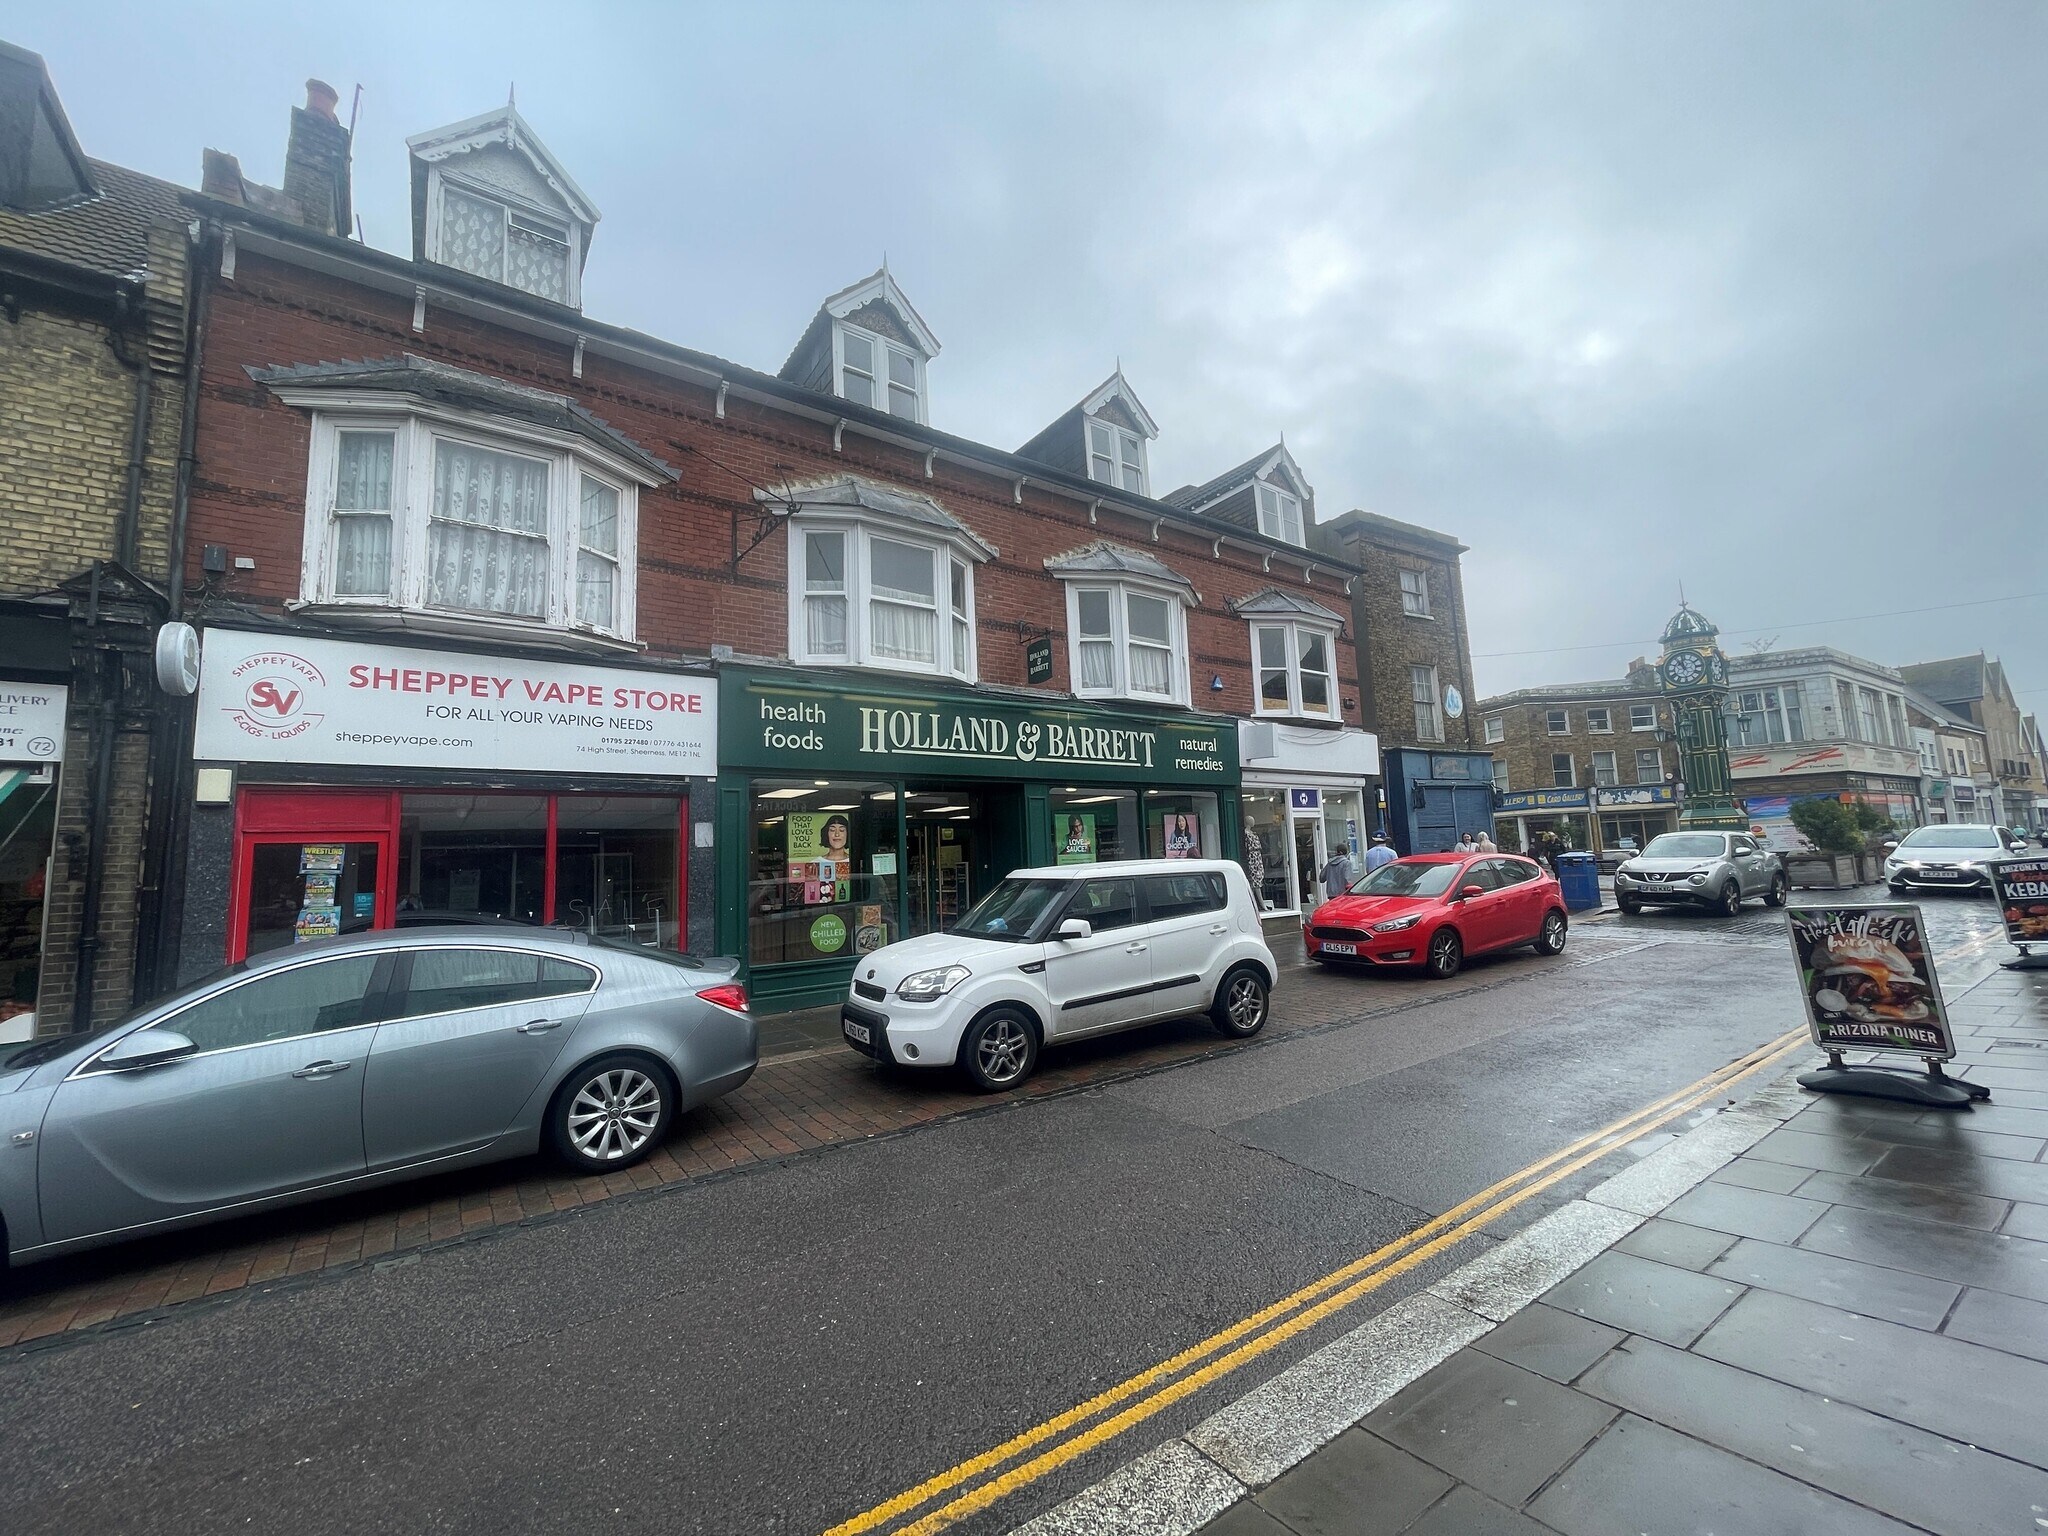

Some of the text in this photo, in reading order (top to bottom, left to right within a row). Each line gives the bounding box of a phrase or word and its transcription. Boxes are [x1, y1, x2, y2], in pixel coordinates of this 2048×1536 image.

[232, 657, 318, 682] SHEPPEY VAPE
[349, 665, 702, 714] SHEPPEY VAPE STORE
[251, 681, 300, 716] SV
[426, 705, 653, 731] FOR ALL YOUR VAPING NEEDS
[760, 698, 826, 724] health
[272, 720, 311, 739] LIQUIDS
[859, 707, 1156, 768] HOLLAND & BARRETT
[33, 741, 51, 752] 72
[335, 731, 473, 748] sheppeyvape.com
[601, 737, 623, 745] 01795
[763, 726, 824, 751] foods
[1179, 737, 1217, 753] natural
[587, 746, 604, 755] High
[1175, 756, 1224, 772] remedies
[304, 847, 343, 855] WRESTLING
[1066, 845, 1087, 853] SAUCE?
[1999, 863, 2039, 874] ARIZONA
[296, 927, 337, 936] WRESTLING
[812, 928, 845, 938] CHILLED
[1801, 916, 1845, 944] Heart
[820, 938, 839, 946] FOOD
[1828, 935, 1890, 956] burger
[1829, 1024, 1938, 1044] ARIZONA DINER
